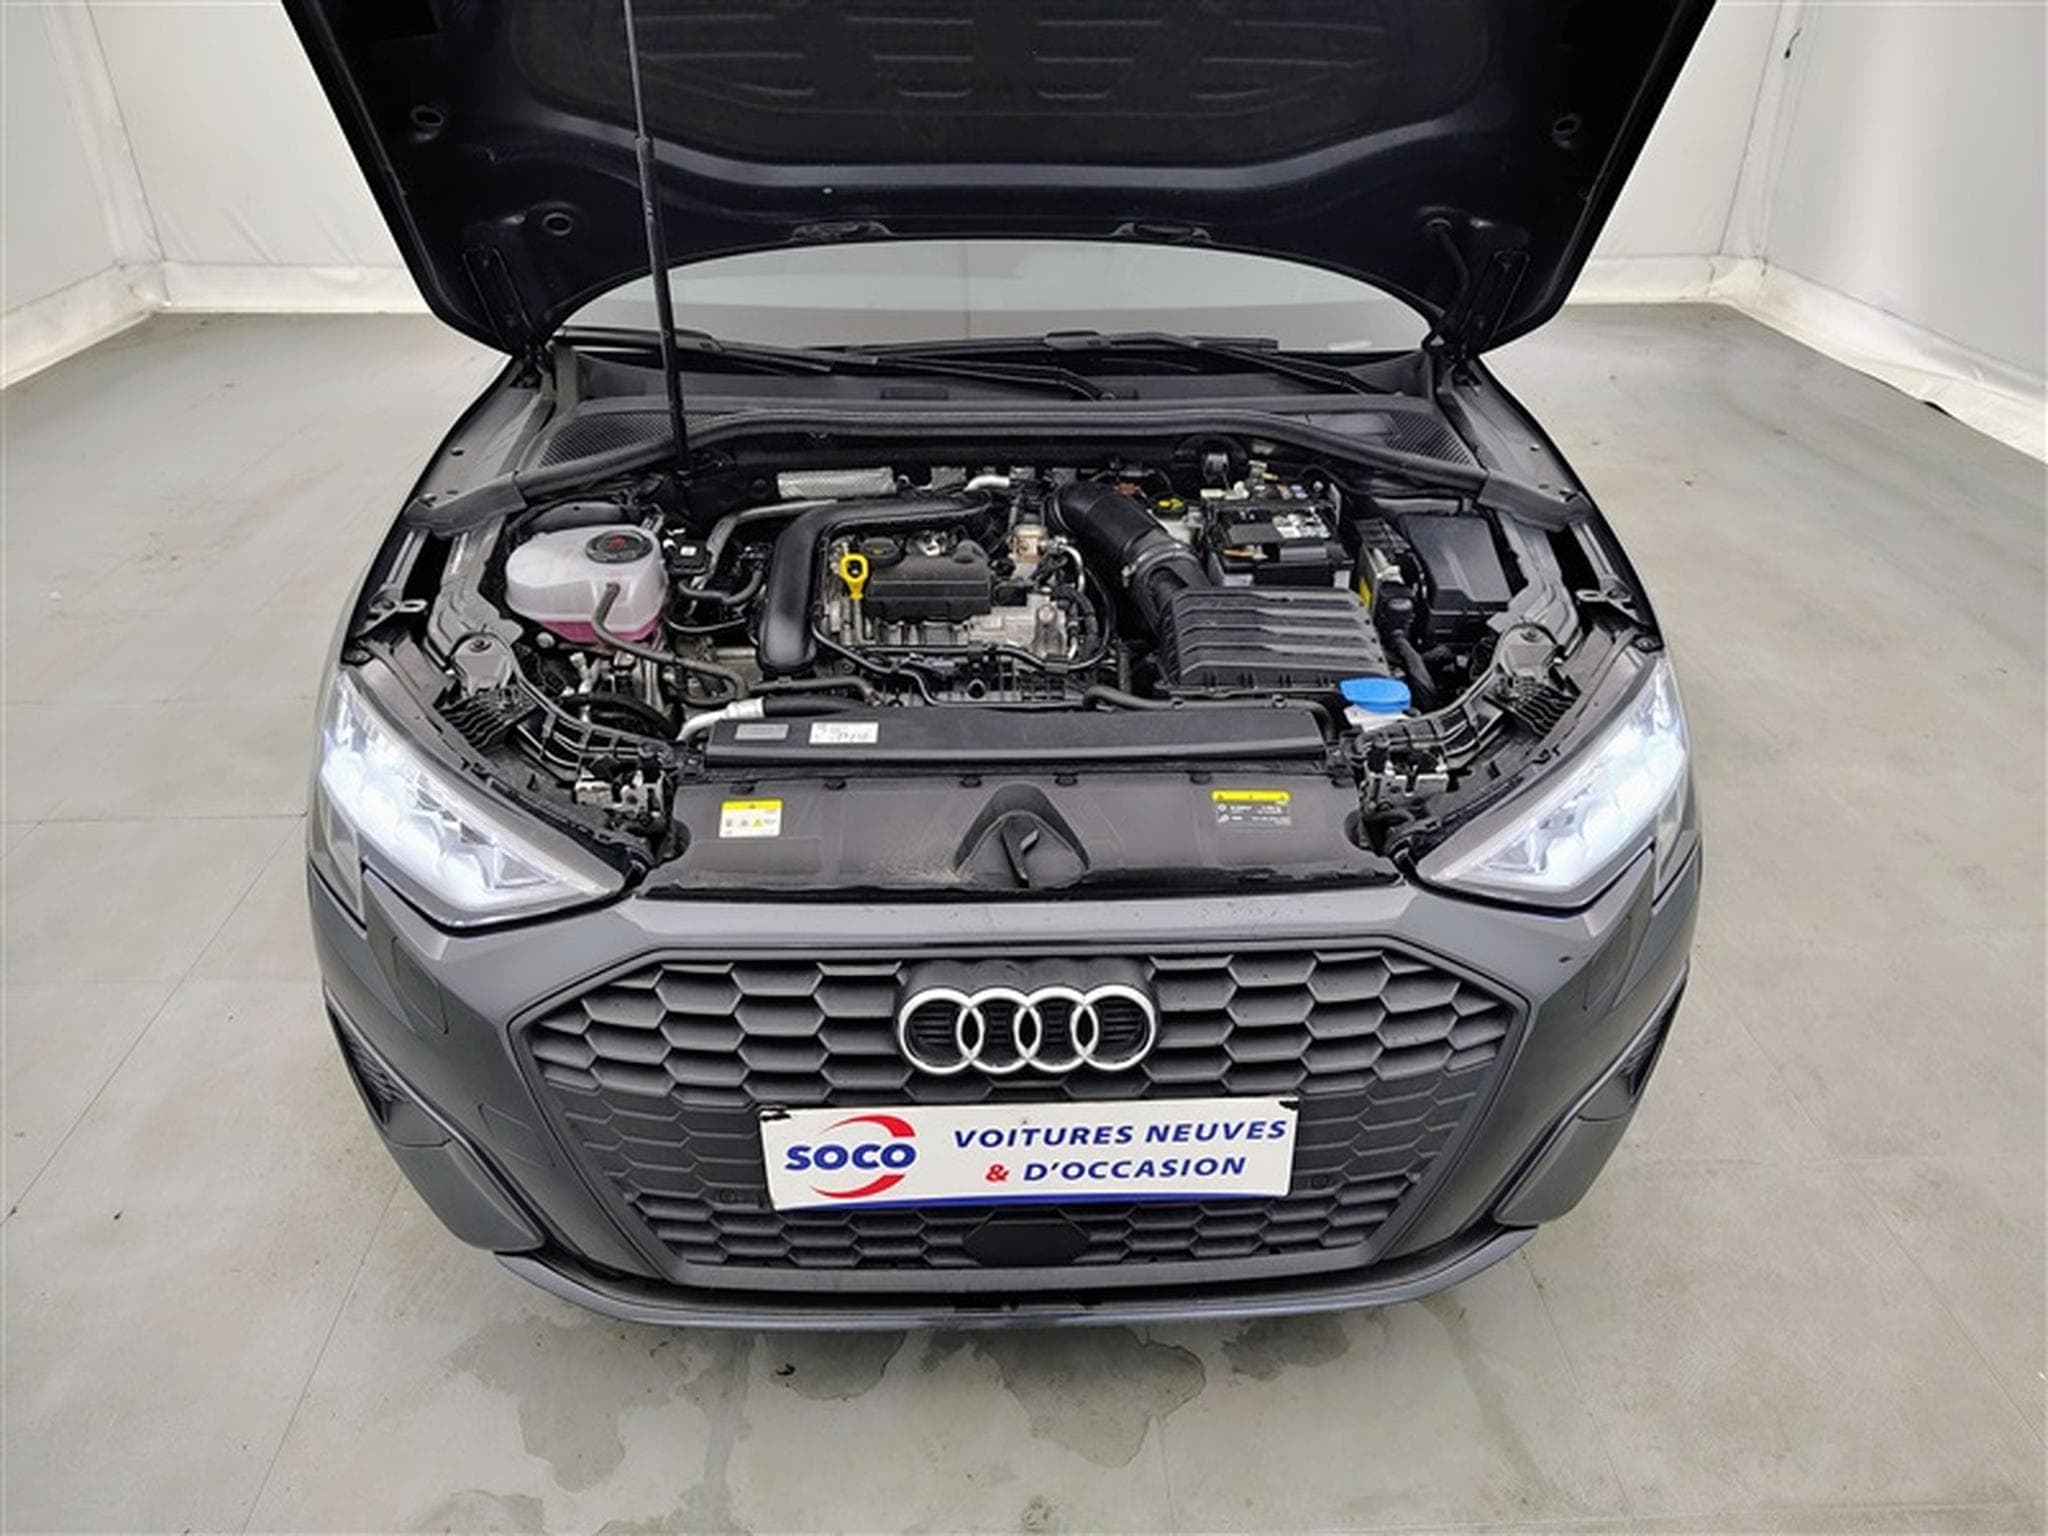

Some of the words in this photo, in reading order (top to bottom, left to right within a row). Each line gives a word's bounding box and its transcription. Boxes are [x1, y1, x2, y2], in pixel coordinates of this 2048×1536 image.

[954, 1125, 1133, 1148] VOITURES
[1145, 1120, 1286, 1143] NEUVES
[785, 1144, 917, 1170] SOCO
[986, 1164, 1009, 1182] &
[1024, 1157, 1246, 1181] D'OCCASION
